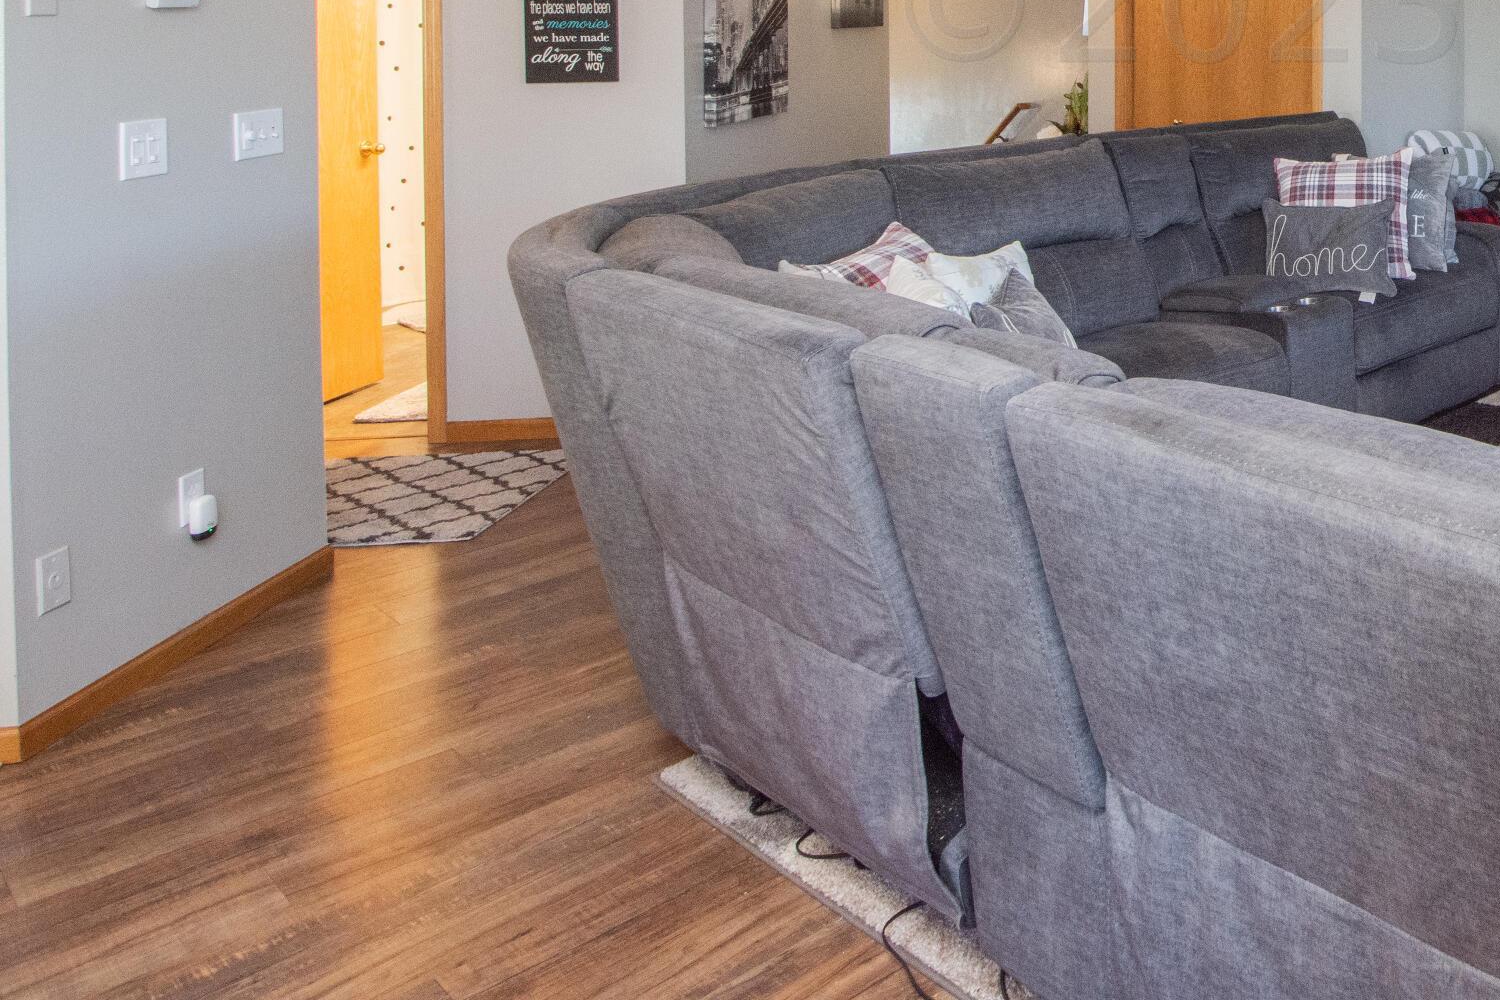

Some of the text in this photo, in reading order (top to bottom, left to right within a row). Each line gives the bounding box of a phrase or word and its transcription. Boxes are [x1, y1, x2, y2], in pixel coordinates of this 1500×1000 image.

[529, 0, 611, 17] the places we have been
[546, 19, 611, 29] memories
[533, 32, 610, 43] we have made
[531, 46, 581, 72] along
[586, 50, 603, 62] the
[585, 62, 605, 74] way
[1266, 214, 1386, 277] home
